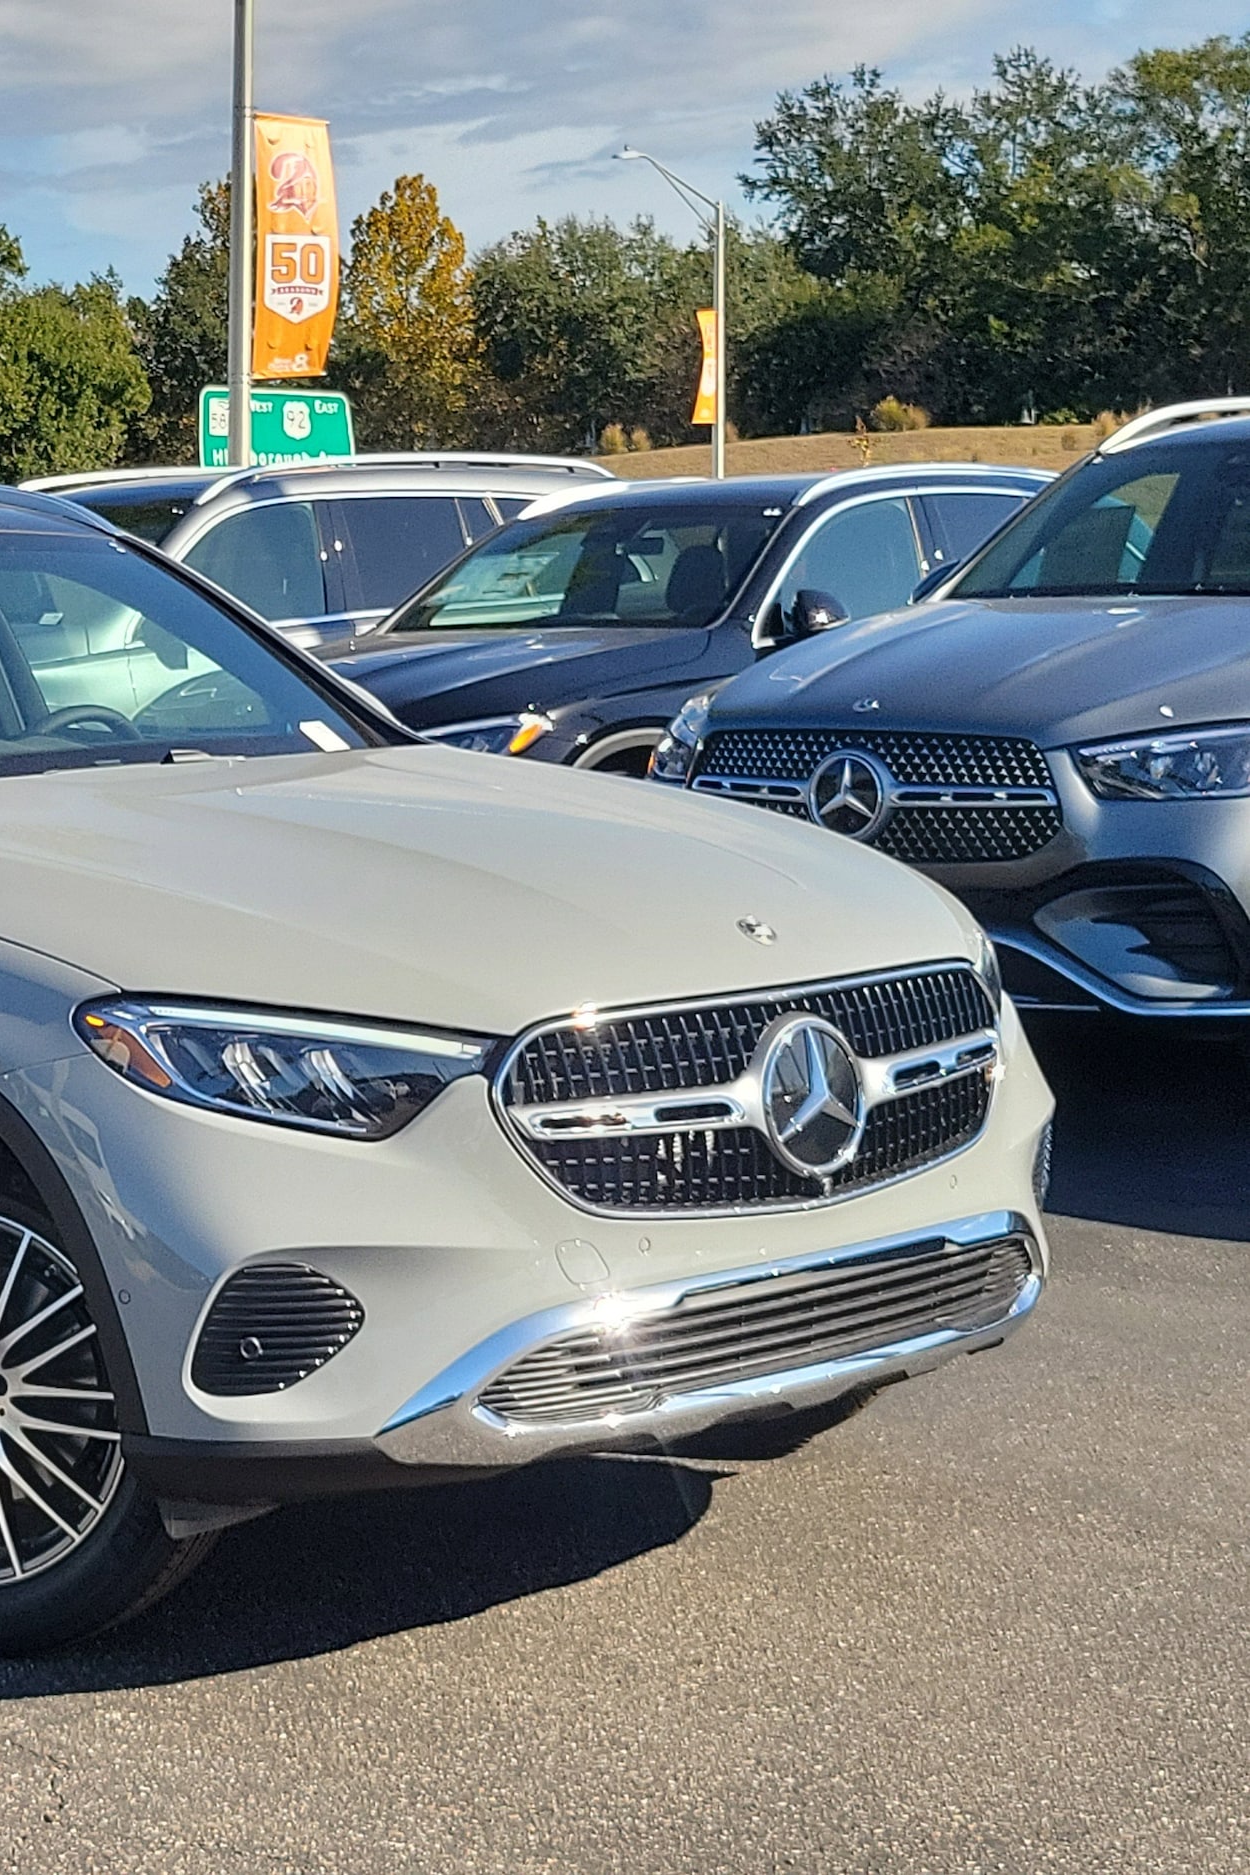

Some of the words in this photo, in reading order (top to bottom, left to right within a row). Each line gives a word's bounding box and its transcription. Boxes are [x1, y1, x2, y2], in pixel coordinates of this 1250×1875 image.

[270, 242, 325, 285] 50
[314, 400, 339, 414] EAST
[286, 410, 306, 430] 92
